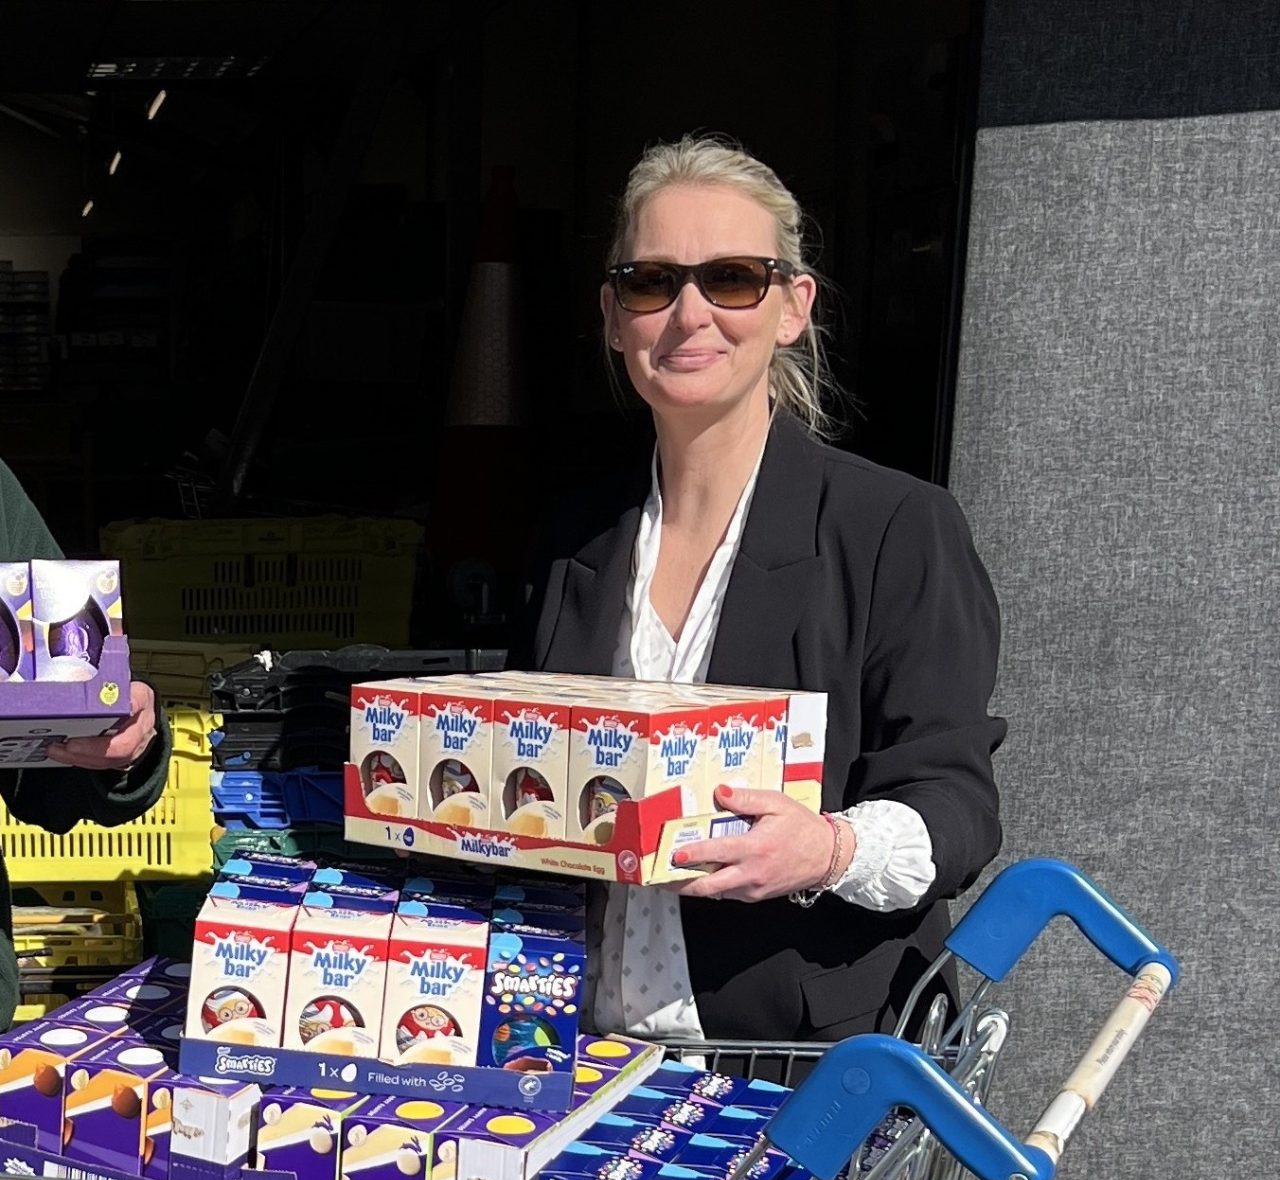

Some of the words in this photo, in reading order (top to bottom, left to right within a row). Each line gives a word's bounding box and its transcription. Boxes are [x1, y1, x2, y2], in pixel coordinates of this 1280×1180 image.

[365, 707, 404, 729] Milky
[436, 714, 477, 737] Milky
[372, 723, 395, 742] bar
[444, 731, 468, 750] bar
[510, 721, 552, 744] Milky
[587, 729, 633, 753] Milky
[719, 727, 754, 753] Milky
[517, 738, 543, 758] bar
[595, 745, 623, 767] bar
[661, 735, 698, 759] Milky
[667, 757, 689, 777] bar
[724, 748, 746, 768] bar
[461, 839, 511, 857] Milkybar
[541, 858, 559, 867] White
[560, 860, 592, 871] Chocolate
[593, 865, 605, 875] Egg
[215, 941, 267, 966] Milky
[314, 951, 367, 976] Milky
[224, 958, 255, 978] bar
[322, 968, 354, 988] bar
[410, 960, 465, 984] Milky
[420, 979, 452, 997] bar
[319, 1062, 326, 1077] 1
[368, 1072, 399, 1085] Filled
[401, 1076, 426, 1087] with
